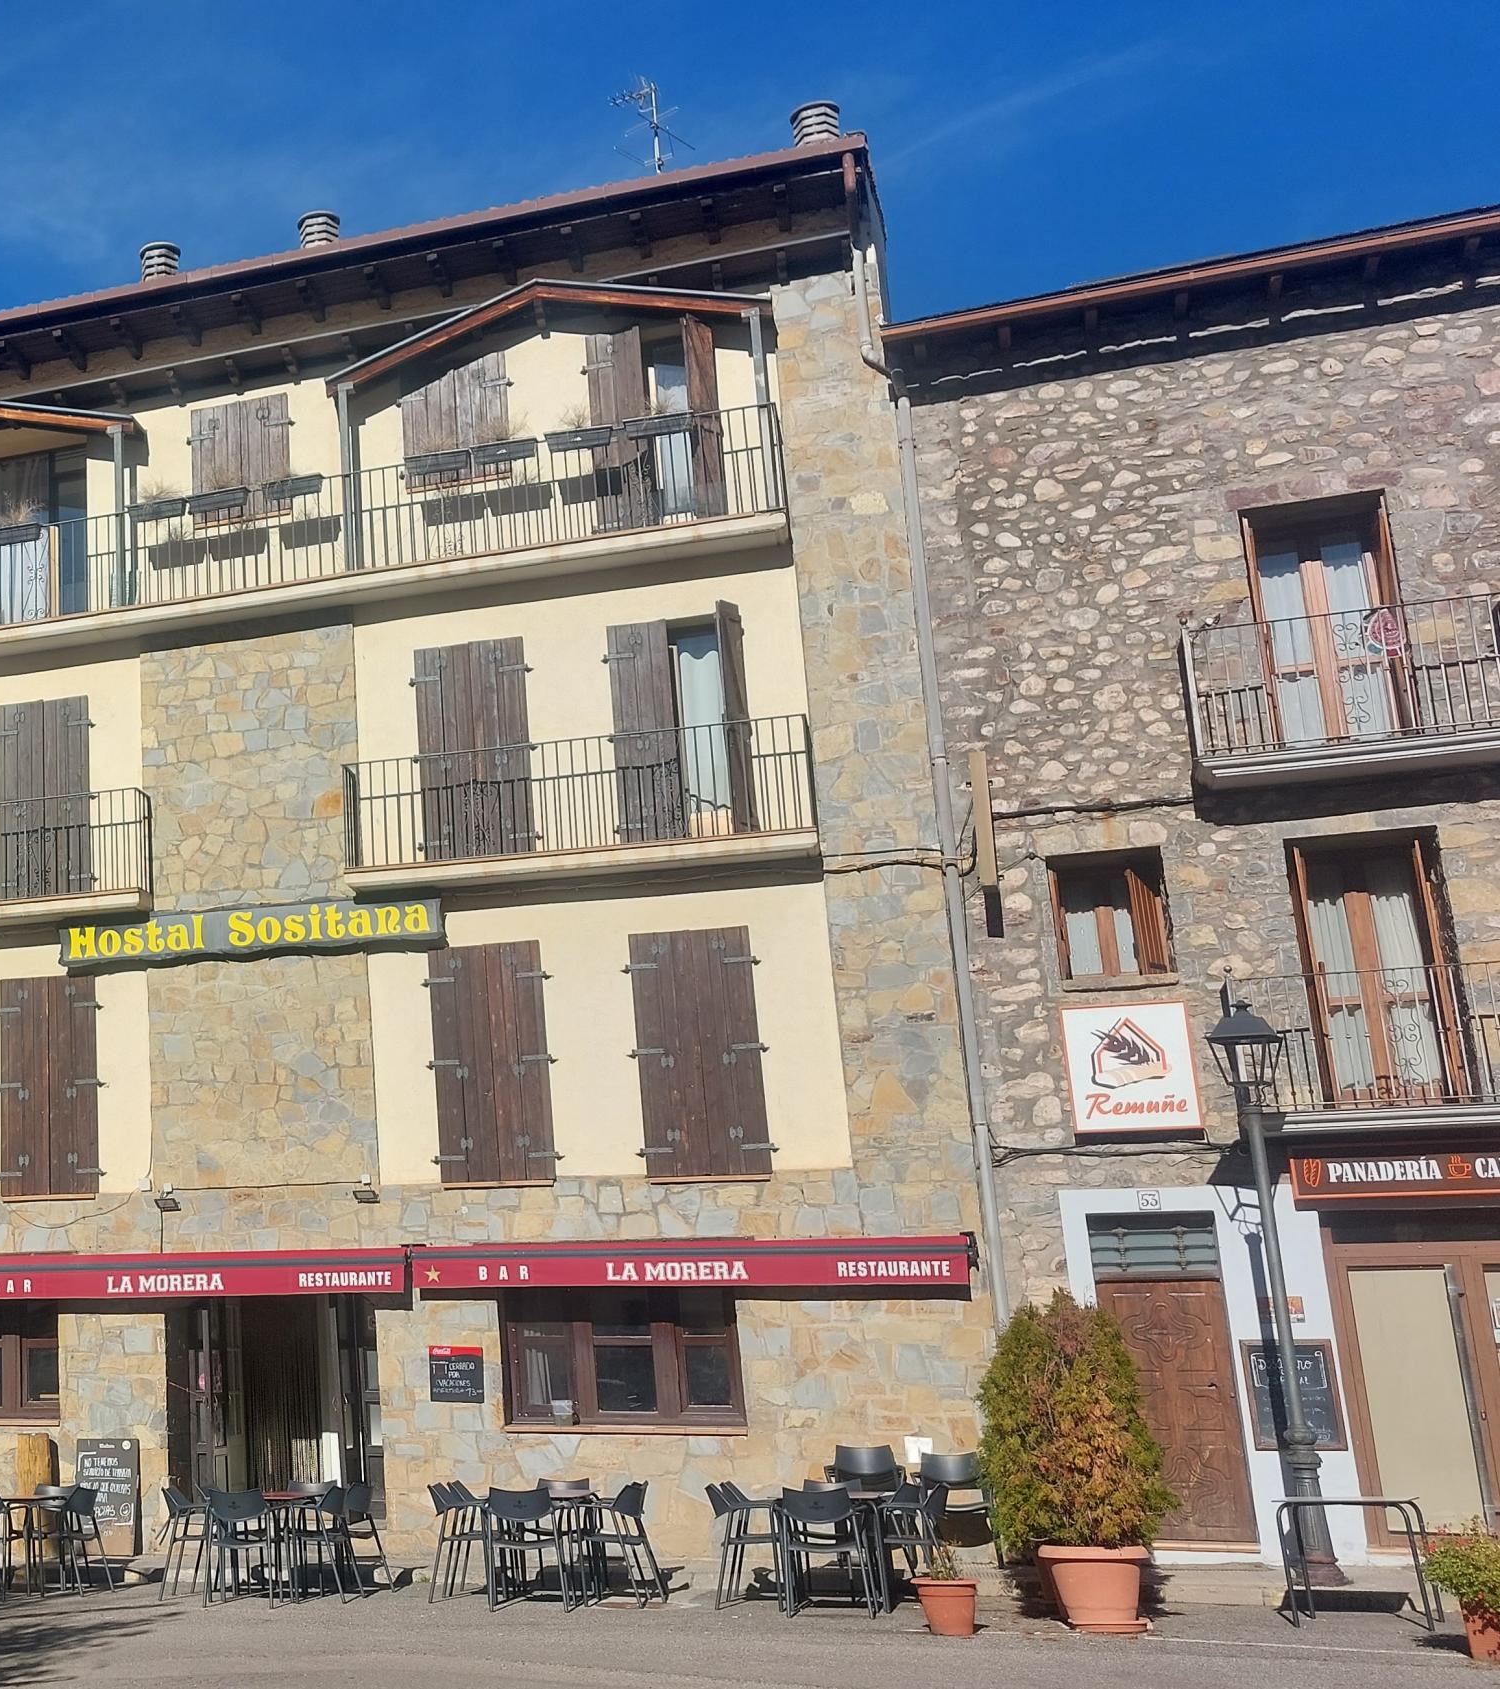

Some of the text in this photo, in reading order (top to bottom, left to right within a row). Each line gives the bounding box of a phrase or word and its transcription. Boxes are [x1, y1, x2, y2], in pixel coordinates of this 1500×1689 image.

[68, 903, 431, 959] Hostal Sositana
[1085, 1093, 1189, 1119] Remuñe
[1326, 1156, 1500, 1183] PANADERÍA CA
[1140, 1193, 1159, 1207] 53
[478, 1259, 951, 1281] BAR LA MORERA RESTAURANTE
[106, 1275, 135, 1294] LA
[138, 1273, 225, 1293] MORERA
[298, 1271, 392, 1288] RESTAURANTE
